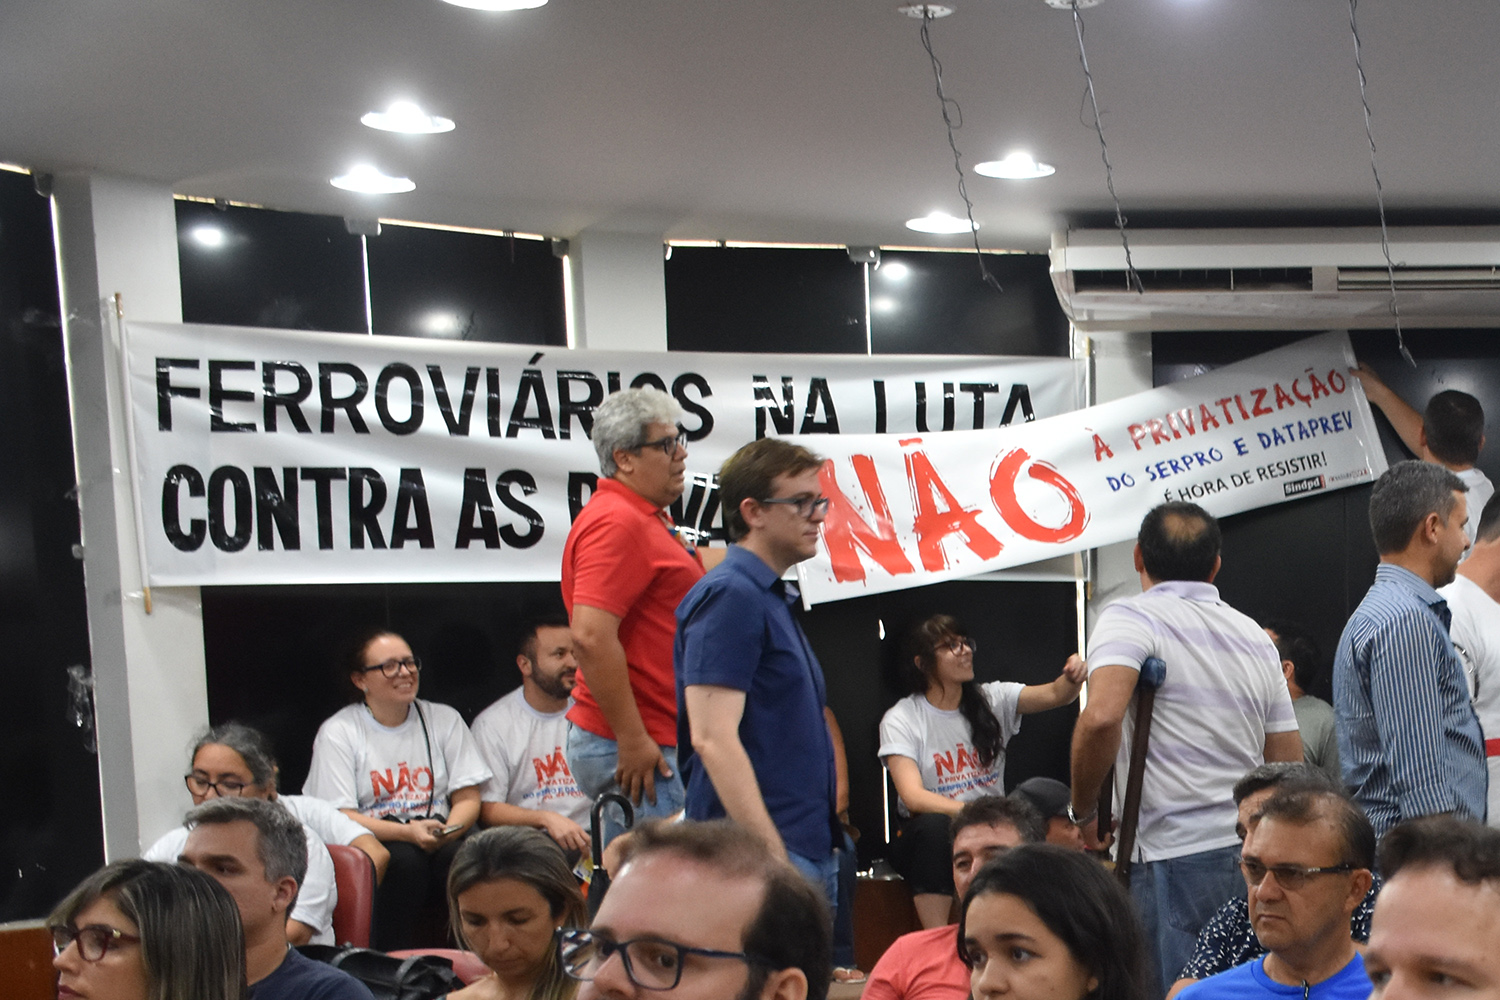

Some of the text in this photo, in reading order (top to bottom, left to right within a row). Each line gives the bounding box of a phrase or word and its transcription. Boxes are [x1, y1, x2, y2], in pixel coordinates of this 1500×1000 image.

[752, 375, 840, 440] NA
[1085, 367, 1346, 462] À PRIVATIZAÇÃO
[1106, 410, 1352, 492] DO SERPRO E DATAPREV
[1178, 478, 1227, 502] HORA
[1233, 470, 1254, 488] DE
[1257, 451, 1328, 481] RESISTIR!
[162, 464, 437, 552] CONTRA
[455, 467, 545, 549] AS
[818, 437, 1091, 584] NÃO
[370, 761, 434, 797] NÃO
[533, 746, 571, 782] NÃ
[933, 743, 984, 776] NÃ
